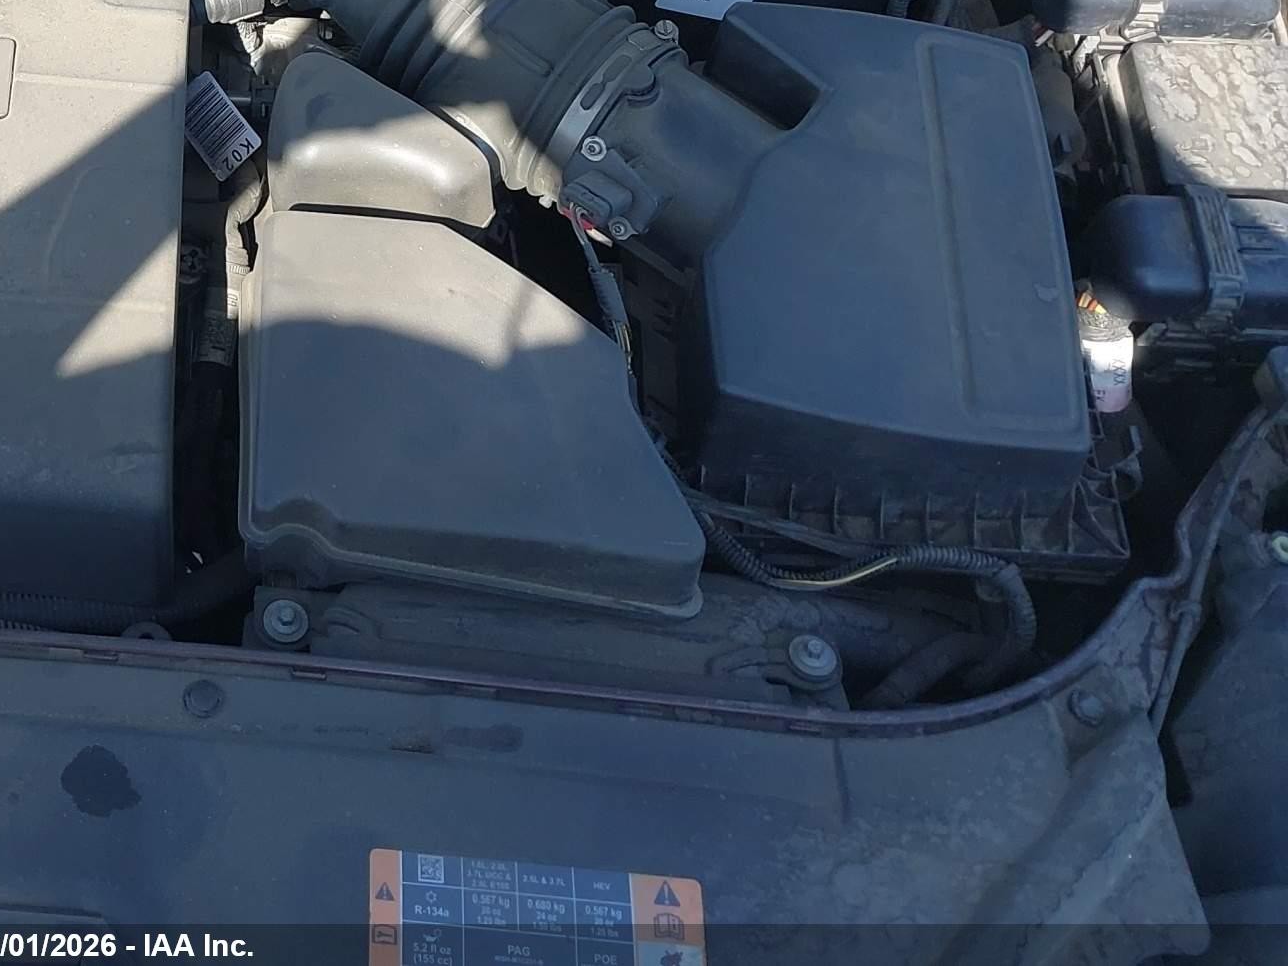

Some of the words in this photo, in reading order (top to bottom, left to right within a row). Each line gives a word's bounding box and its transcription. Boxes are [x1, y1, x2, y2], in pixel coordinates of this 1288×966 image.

[222, 137, 255, 172] K02
[593, 882, 611, 891] HEV
[414, 904, 450, 918] R-134a
[611, 908, 623, 921] kg
[413, 942, 429, 954] 5.2
[440, 945, 452, 955] oz
[507, 945, 531, 956] PAG
[413, 953, 437, 965] (155
[438, 956, 453, 966] cc)
[593, 953, 618, 964] POE
